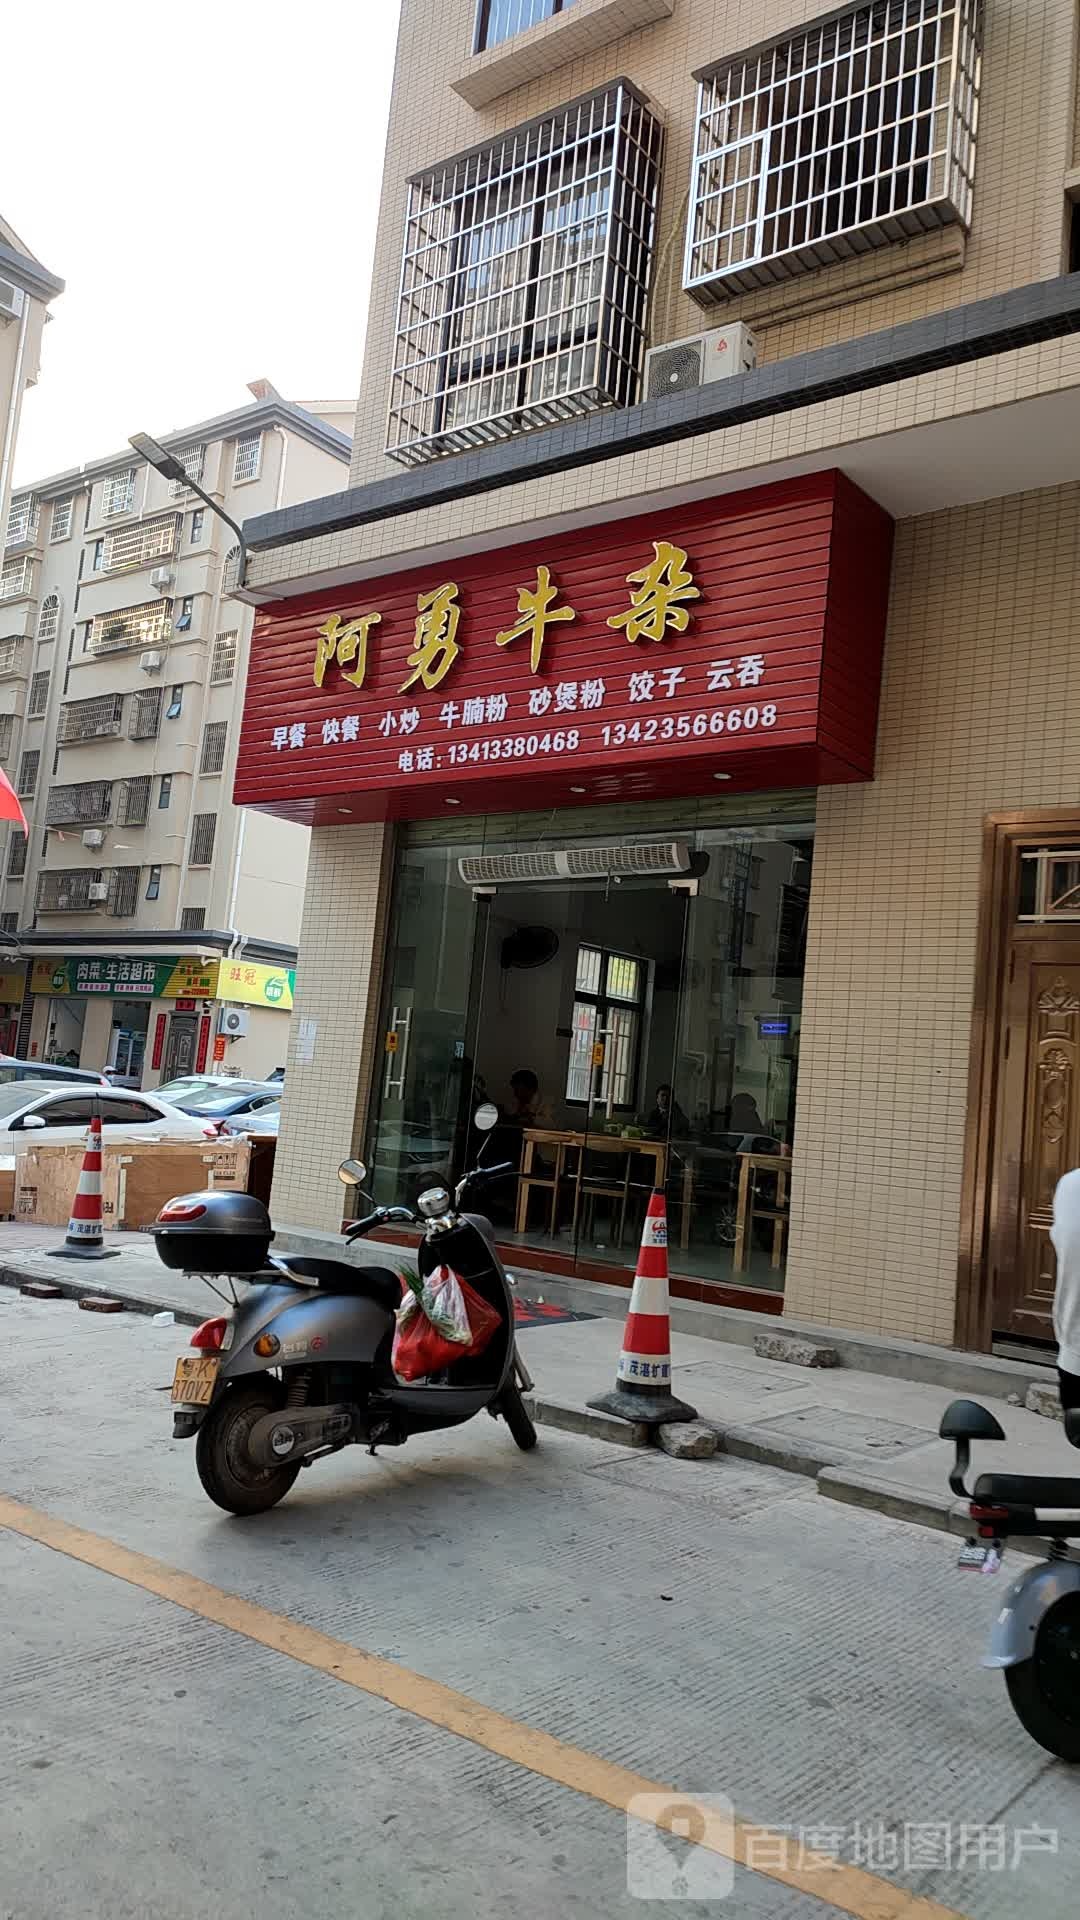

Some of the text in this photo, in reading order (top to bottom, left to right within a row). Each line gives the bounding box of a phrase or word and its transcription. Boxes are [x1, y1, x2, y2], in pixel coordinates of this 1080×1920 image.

[313, 541, 700, 693] 阿勇牛杂
[271, 654, 765, 750] 早餐 快餐 小炒 牛腩粉 砂煲粉 饺子 云吞
[601, 704, 777, 746] 13423566608
